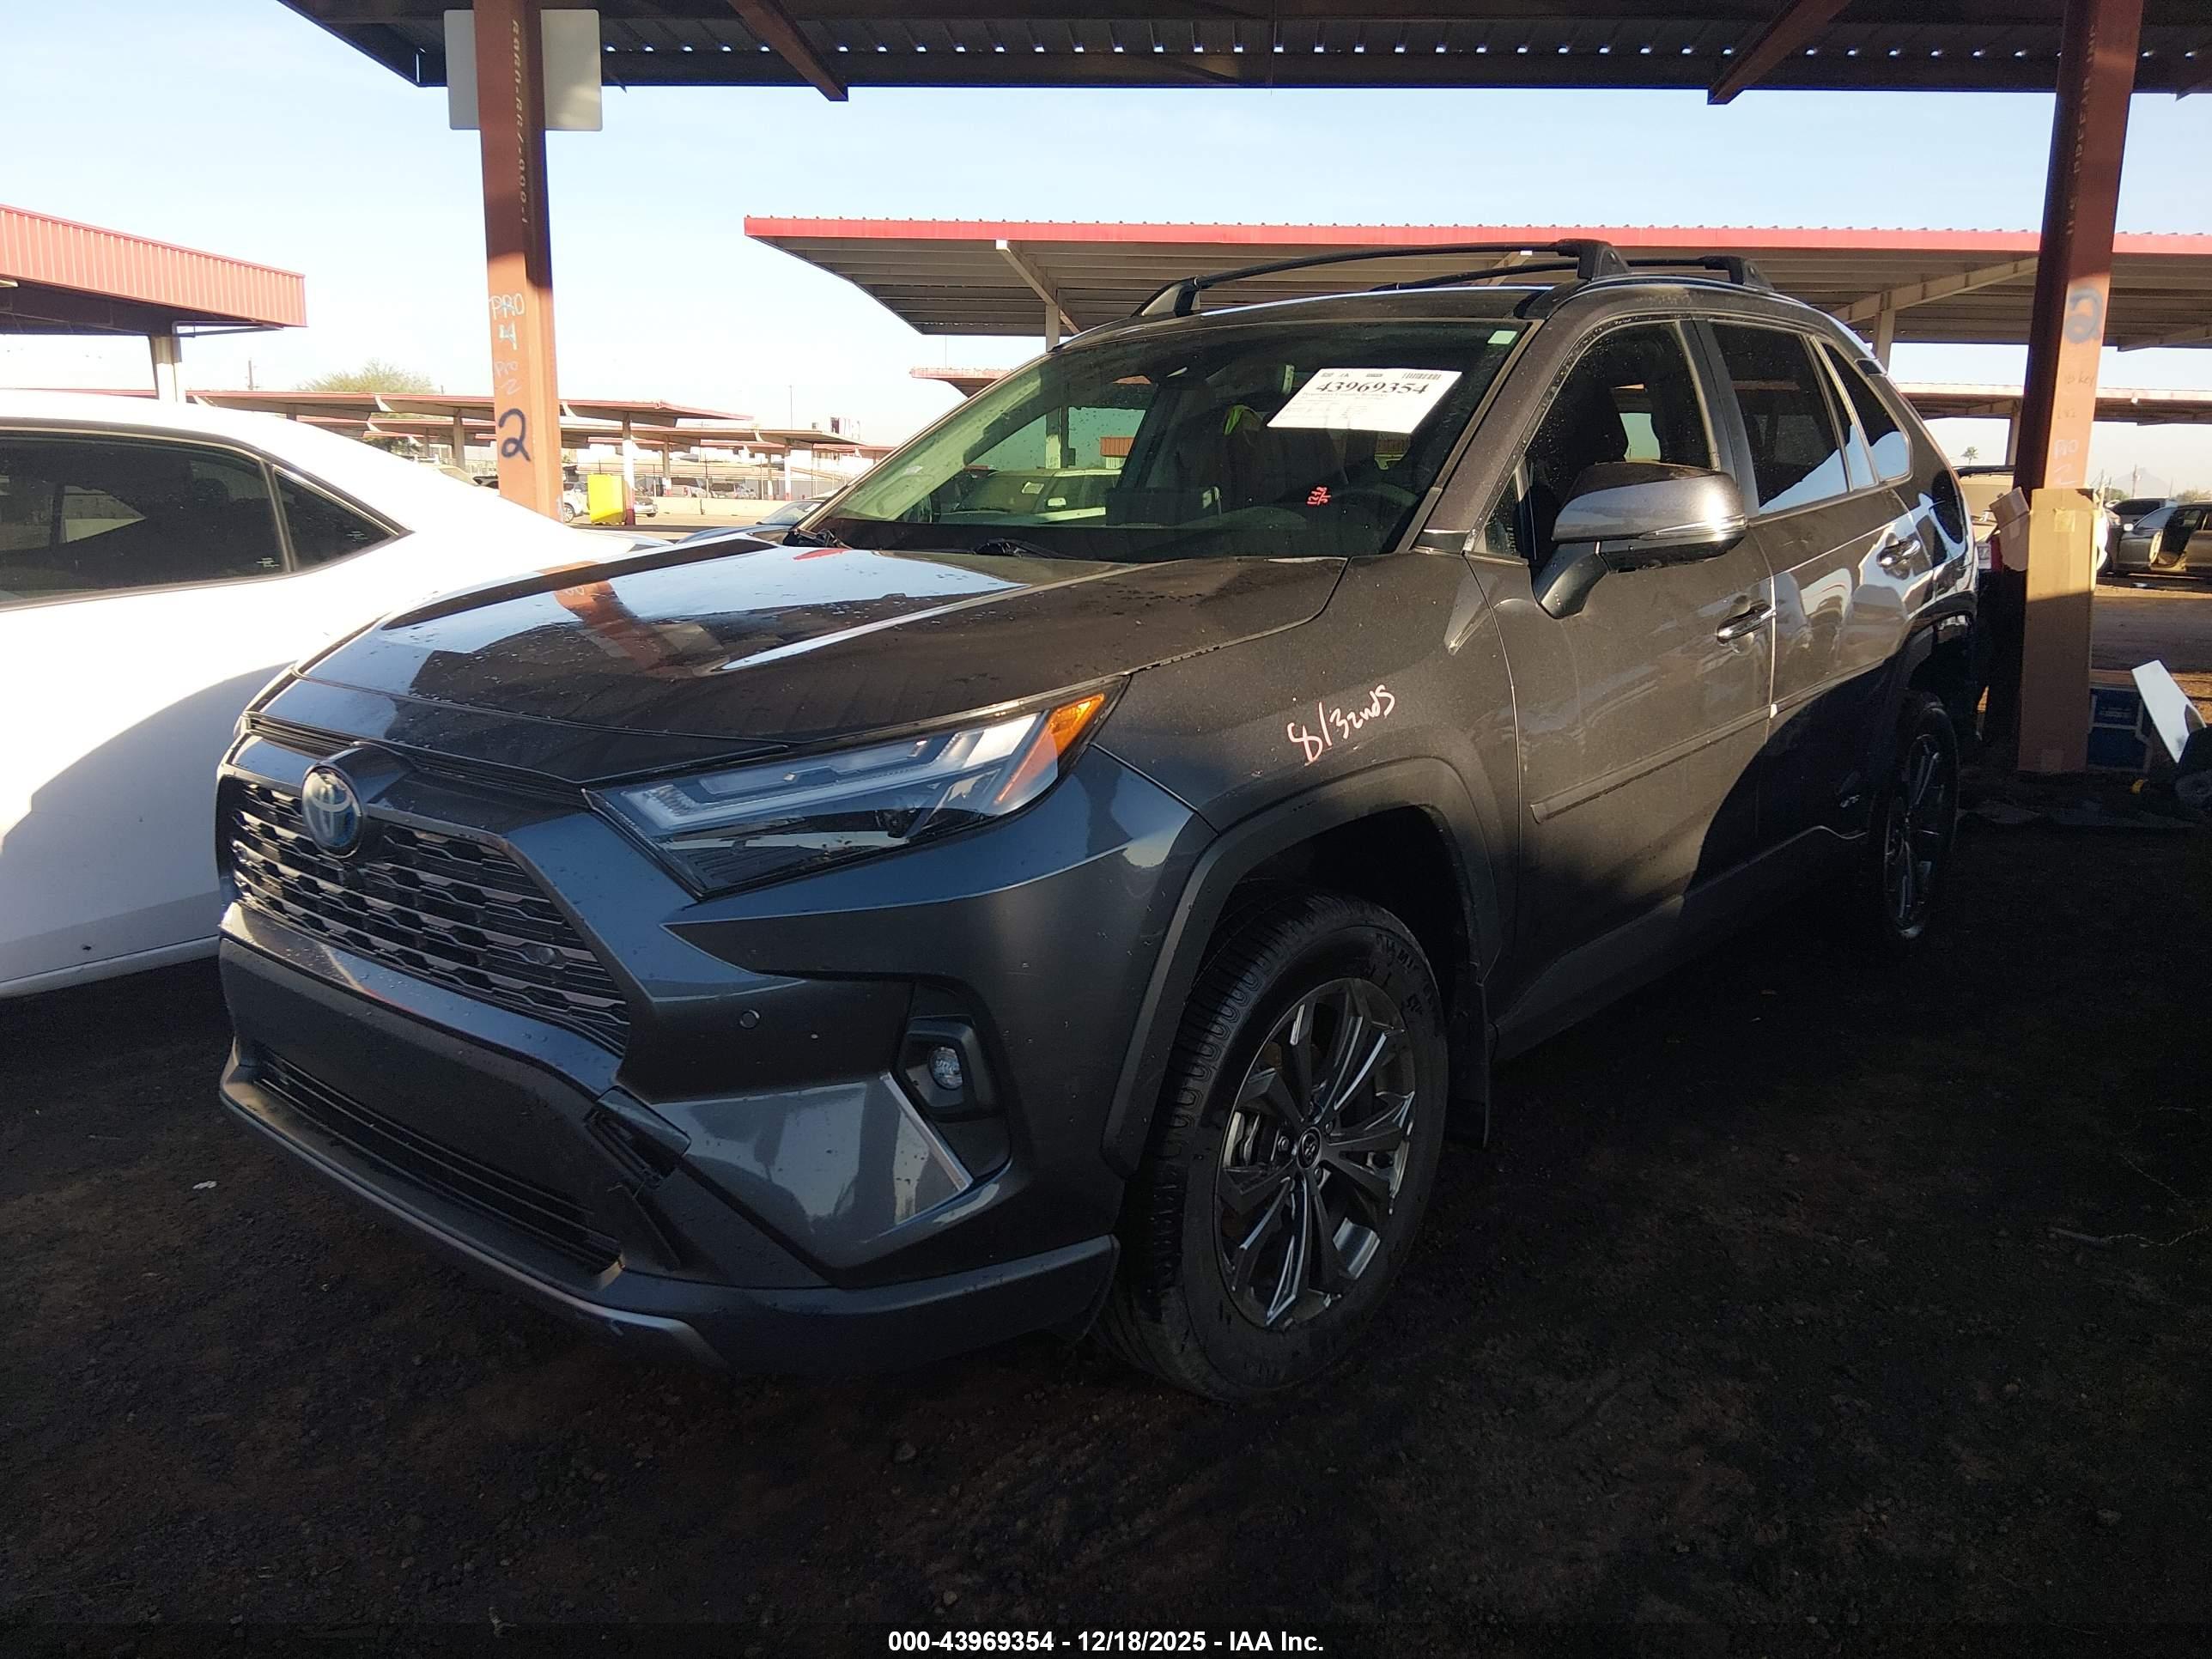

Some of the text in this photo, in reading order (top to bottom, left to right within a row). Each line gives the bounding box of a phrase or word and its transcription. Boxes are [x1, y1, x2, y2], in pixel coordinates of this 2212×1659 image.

[490, 293, 526, 320] PRO
[2063, 286, 2103, 344] 2
[499, 321, 517, 350] 4
[1316, 380, 1430, 394] 43969354
[498, 407, 532, 463] 2
